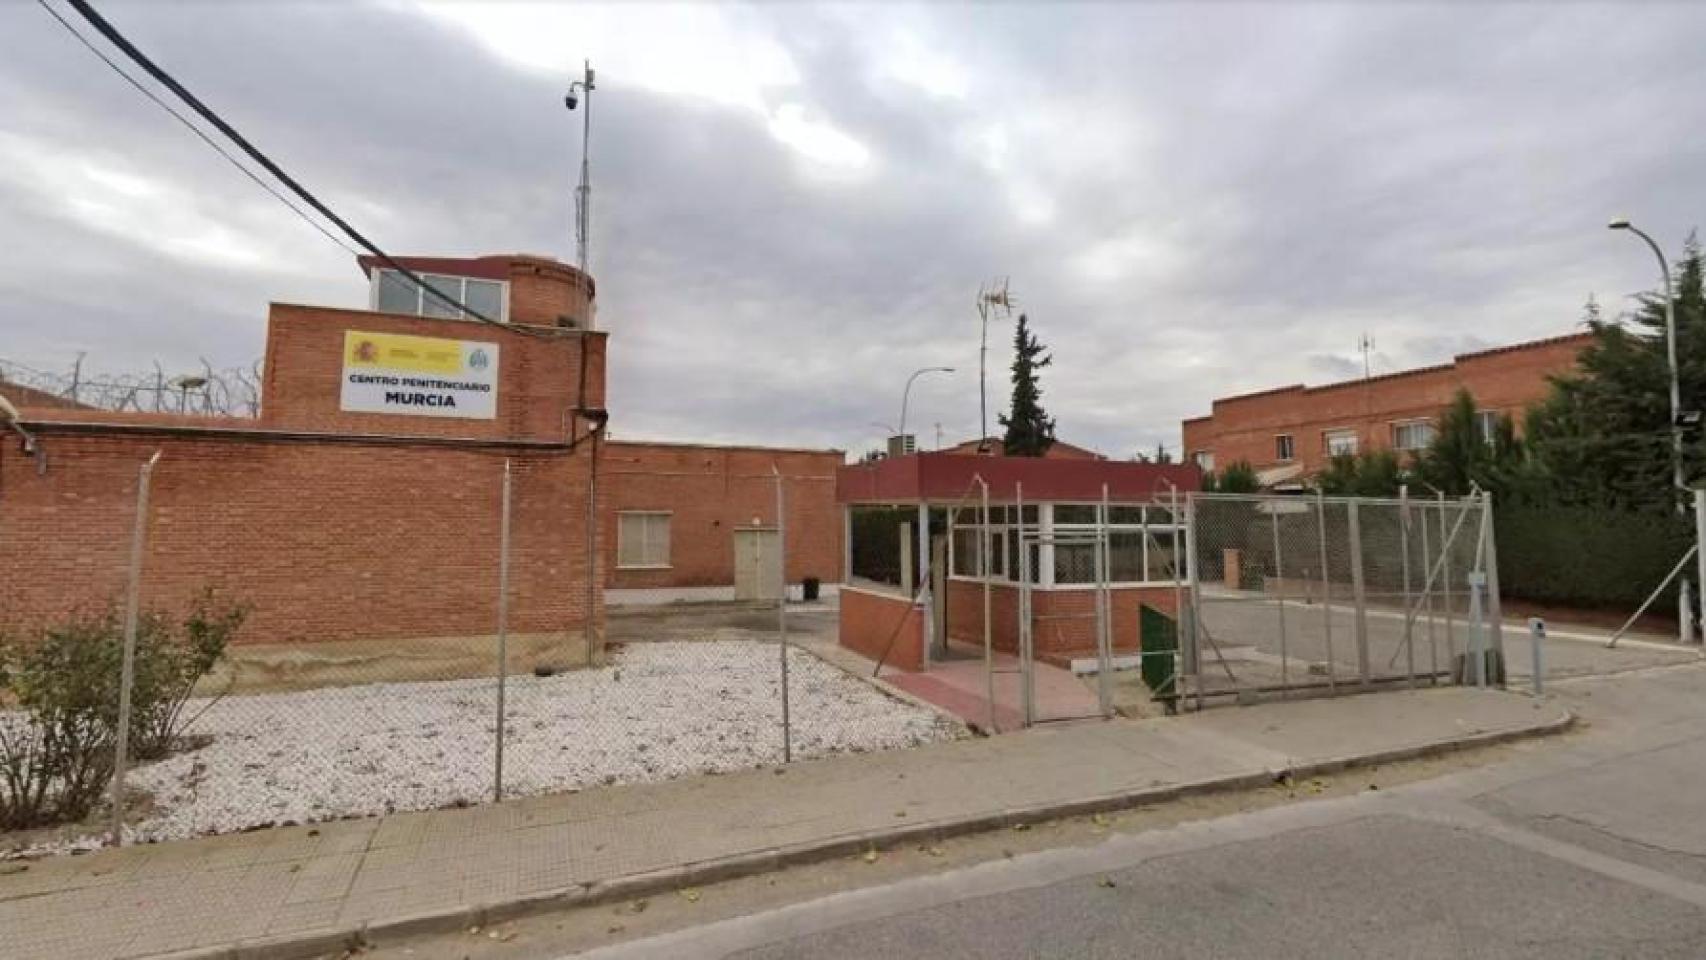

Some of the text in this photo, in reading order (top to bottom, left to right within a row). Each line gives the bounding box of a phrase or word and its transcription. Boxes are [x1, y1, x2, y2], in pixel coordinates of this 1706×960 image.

[349, 374, 490, 392] CENTRO PENITENCIARIO
[385, 391, 456, 407] MURCIA
